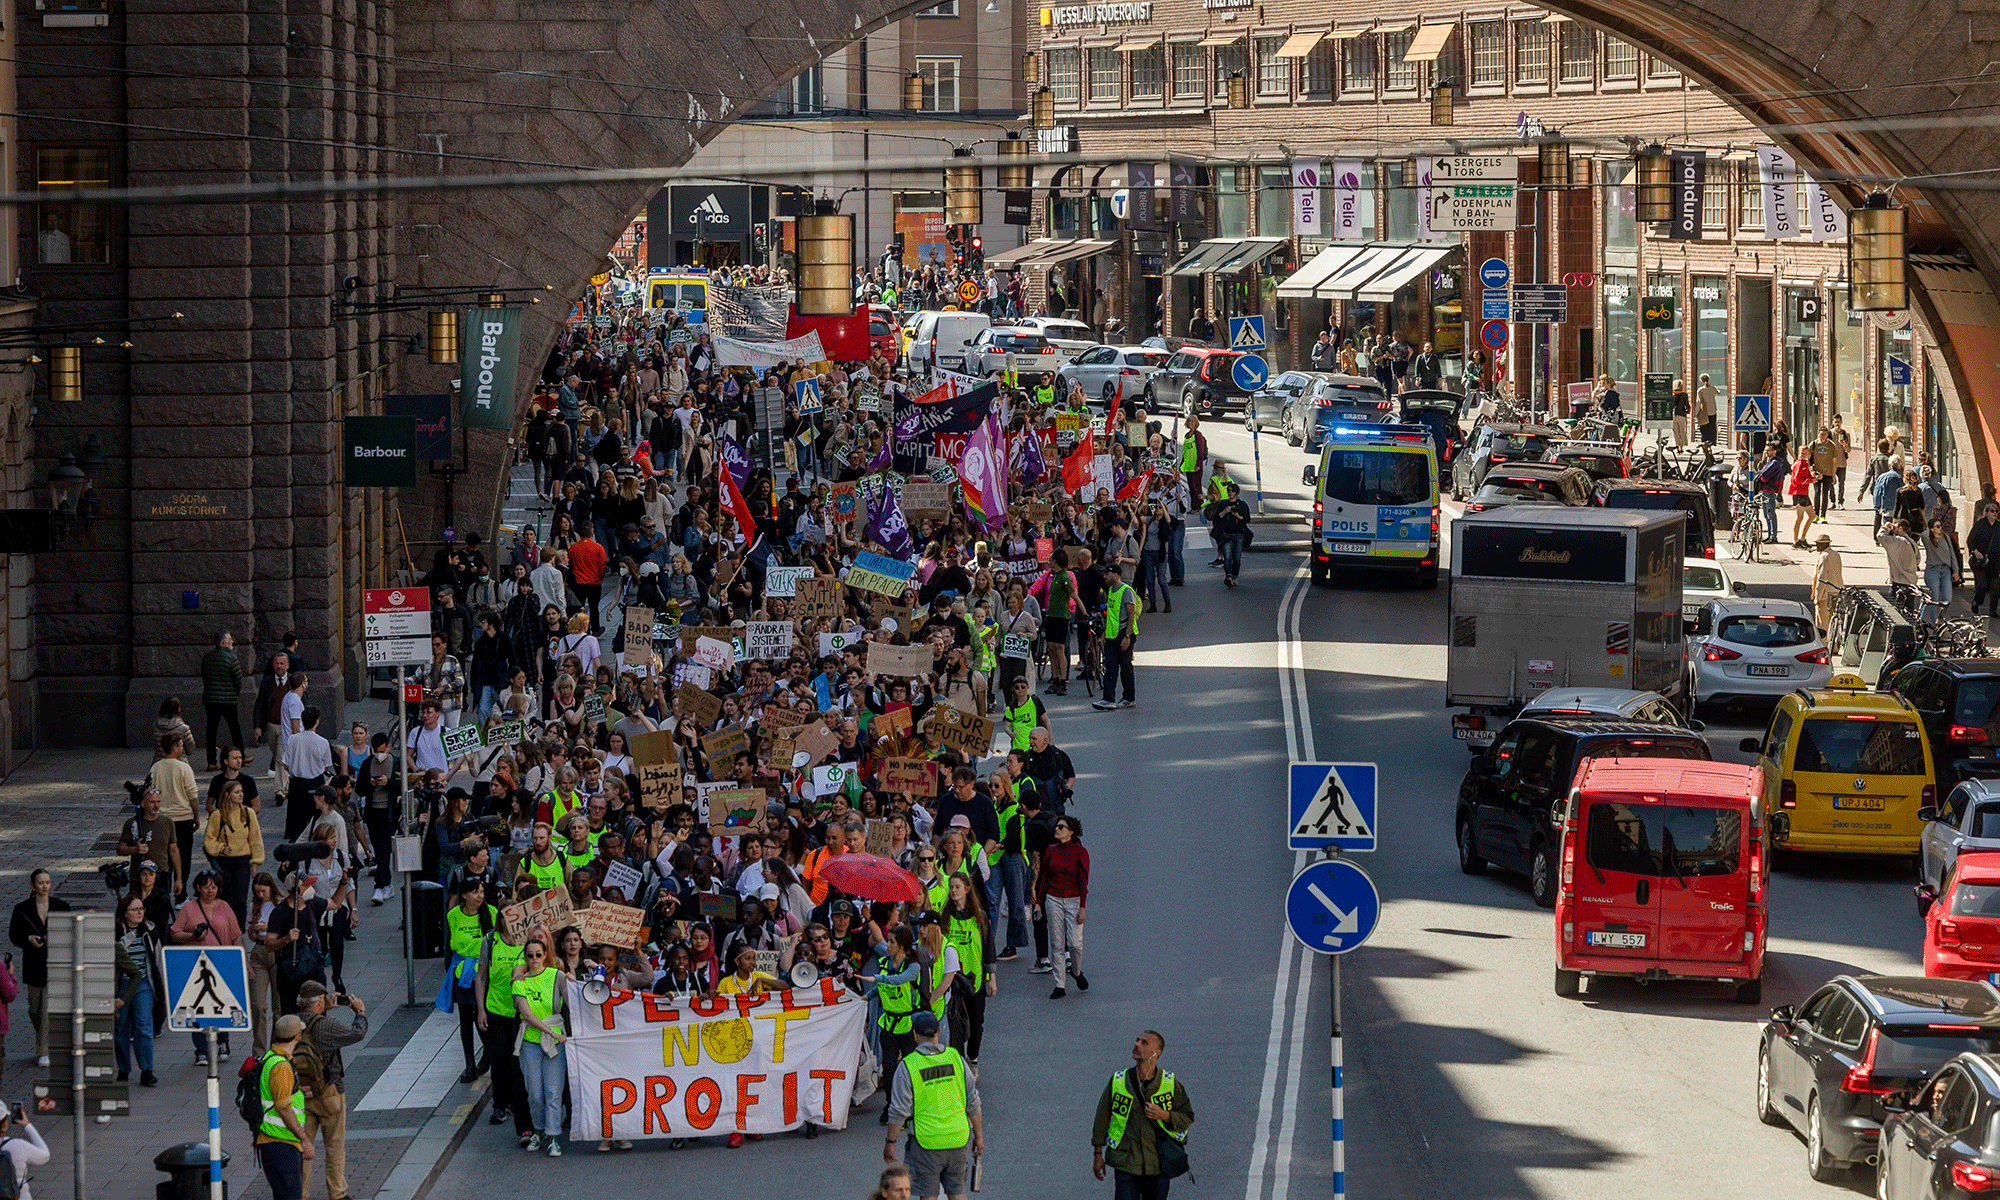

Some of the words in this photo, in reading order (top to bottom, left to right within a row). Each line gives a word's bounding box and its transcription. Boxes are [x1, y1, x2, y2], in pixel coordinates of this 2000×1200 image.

[1051, 8, 1094, 24] WESSLAU
[1096, 1, 1151, 22] SÖDERQVIST
[1454, 158, 1502, 167] SERGELS
[1454, 168, 1484, 177] TORG
[1459, 186, 1474, 196] E4
[1484, 186, 1508, 196] E20
[1682, 156, 1696, 232] panduro
[1771, 153, 1789, 231] ALEWALDS
[1115, 196, 1126, 215] T
[1139, 189, 1148, 222] telenor
[1302, 191, 1314, 224] Telia
[1453, 199, 1512, 208] ODENPLAN
[1342, 194, 1355, 228] Telia
[1453, 209, 1461, 218] N
[1467, 208, 1496, 218] BAN-
[1453, 218, 1495, 227] TORGET
[1440, 274, 1454, 289] Telia
[718, 288, 742, 302] UN
[762, 288, 786, 301] WEF
[962, 286, 976, 296] 40
[1604, 284, 1629, 298] smarteyes
[1694, 286, 1719, 302] smarteyes
[710, 305, 751, 316] WORLD
[710, 316, 762, 326] ECONOMIC
[710, 326, 747, 336] FORUM
[785, 334, 819, 352] CHANGING
[741, 350, 763, 361] WHY
[802, 346, 822, 358] WE?
[936, 371, 947, 380] NO
[1056, 430, 1074, 438] STOP
[172, 493, 208, 504] SÖDRA
[152, 506, 227, 516] KUNGSTORNET
[1332, 520, 1369, 532] POLIS
[1336, 544, 1350, 552] RES
[798, 580, 842, 592] STAND
[850, 570, 868, 586] FOR
[867, 573, 906, 596] PEACE!
[803, 590, 837, 603] WITH
[366, 626, 380, 636] 75
[628, 622, 650, 634] BAD
[754, 622, 785, 634] ÄNDRA
[626, 634, 652, 647] SIGN
[752, 635, 787, 646] SYSTEMET
[1005, 637, 1028, 648] STOP
[368, 642, 380, 651] 91
[748, 646, 762, 658] INTE
[763, 646, 791, 658] KLIMATET
[1005, 646, 1028, 654] ECOCIDE
[368, 652, 387, 661] 291
[1754, 666, 1768, 674] PNA
[1772, 666, 1786, 674] 198
[586, 700, 602, 712] STOP
[767, 707, 779, 716] THE
[489, 724, 520, 737] STOP
[1905, 730, 1920, 739] 261
[445, 728, 476, 746] STOP
[488, 732, 520, 743] ECOCIDE
[934, 722, 990, 754] FUTURES
[448, 738, 480, 752] ECOCIDE
[904, 762, 924, 770] MORE
[1842, 798, 1862, 808] UPJ
[1863, 799, 1881, 808] 404
[873, 824, 892, 833] THE
[872, 832, 890, 841] END
[621, 872, 636, 882] killing
[505, 890, 556, 924] STOP
[591, 902, 607, 910] Dear
[1710, 902, 1734, 910] Trafic
[511, 899, 569, 933] INVESTING
[588, 912, 603, 920] girls
[614, 916, 630, 924] heart
[1593, 932, 1614, 944] LWY
[1622, 934, 1644, 945] 557
[662, 1008, 811, 1068] NOT
[601, 1070, 846, 1139] PROFIT
[1114, 1094, 1128, 1105] DIA
[1154, 1094, 1172, 1104] LOG
[1112, 1102, 1128, 1114] PO
